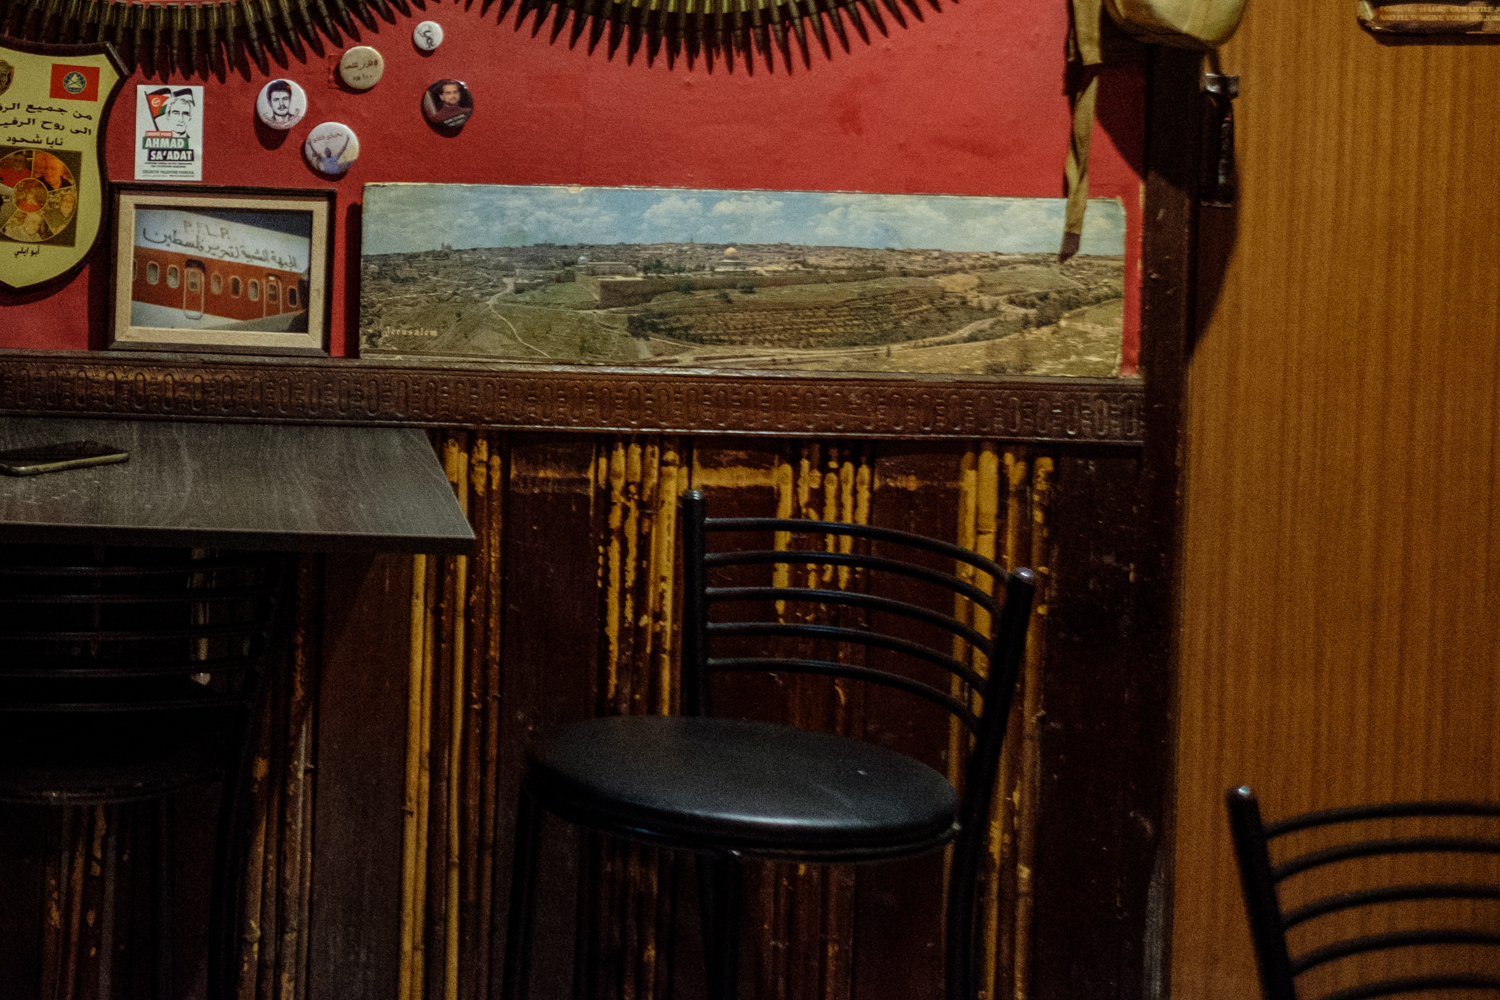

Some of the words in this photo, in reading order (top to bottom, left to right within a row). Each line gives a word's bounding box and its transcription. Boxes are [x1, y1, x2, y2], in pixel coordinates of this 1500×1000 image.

[25, 103, 68, 115] جميع
[72, 110, 93, 121] من
[40, 119, 65, 130] روح
[144, 137, 185, 148] AHMAD
